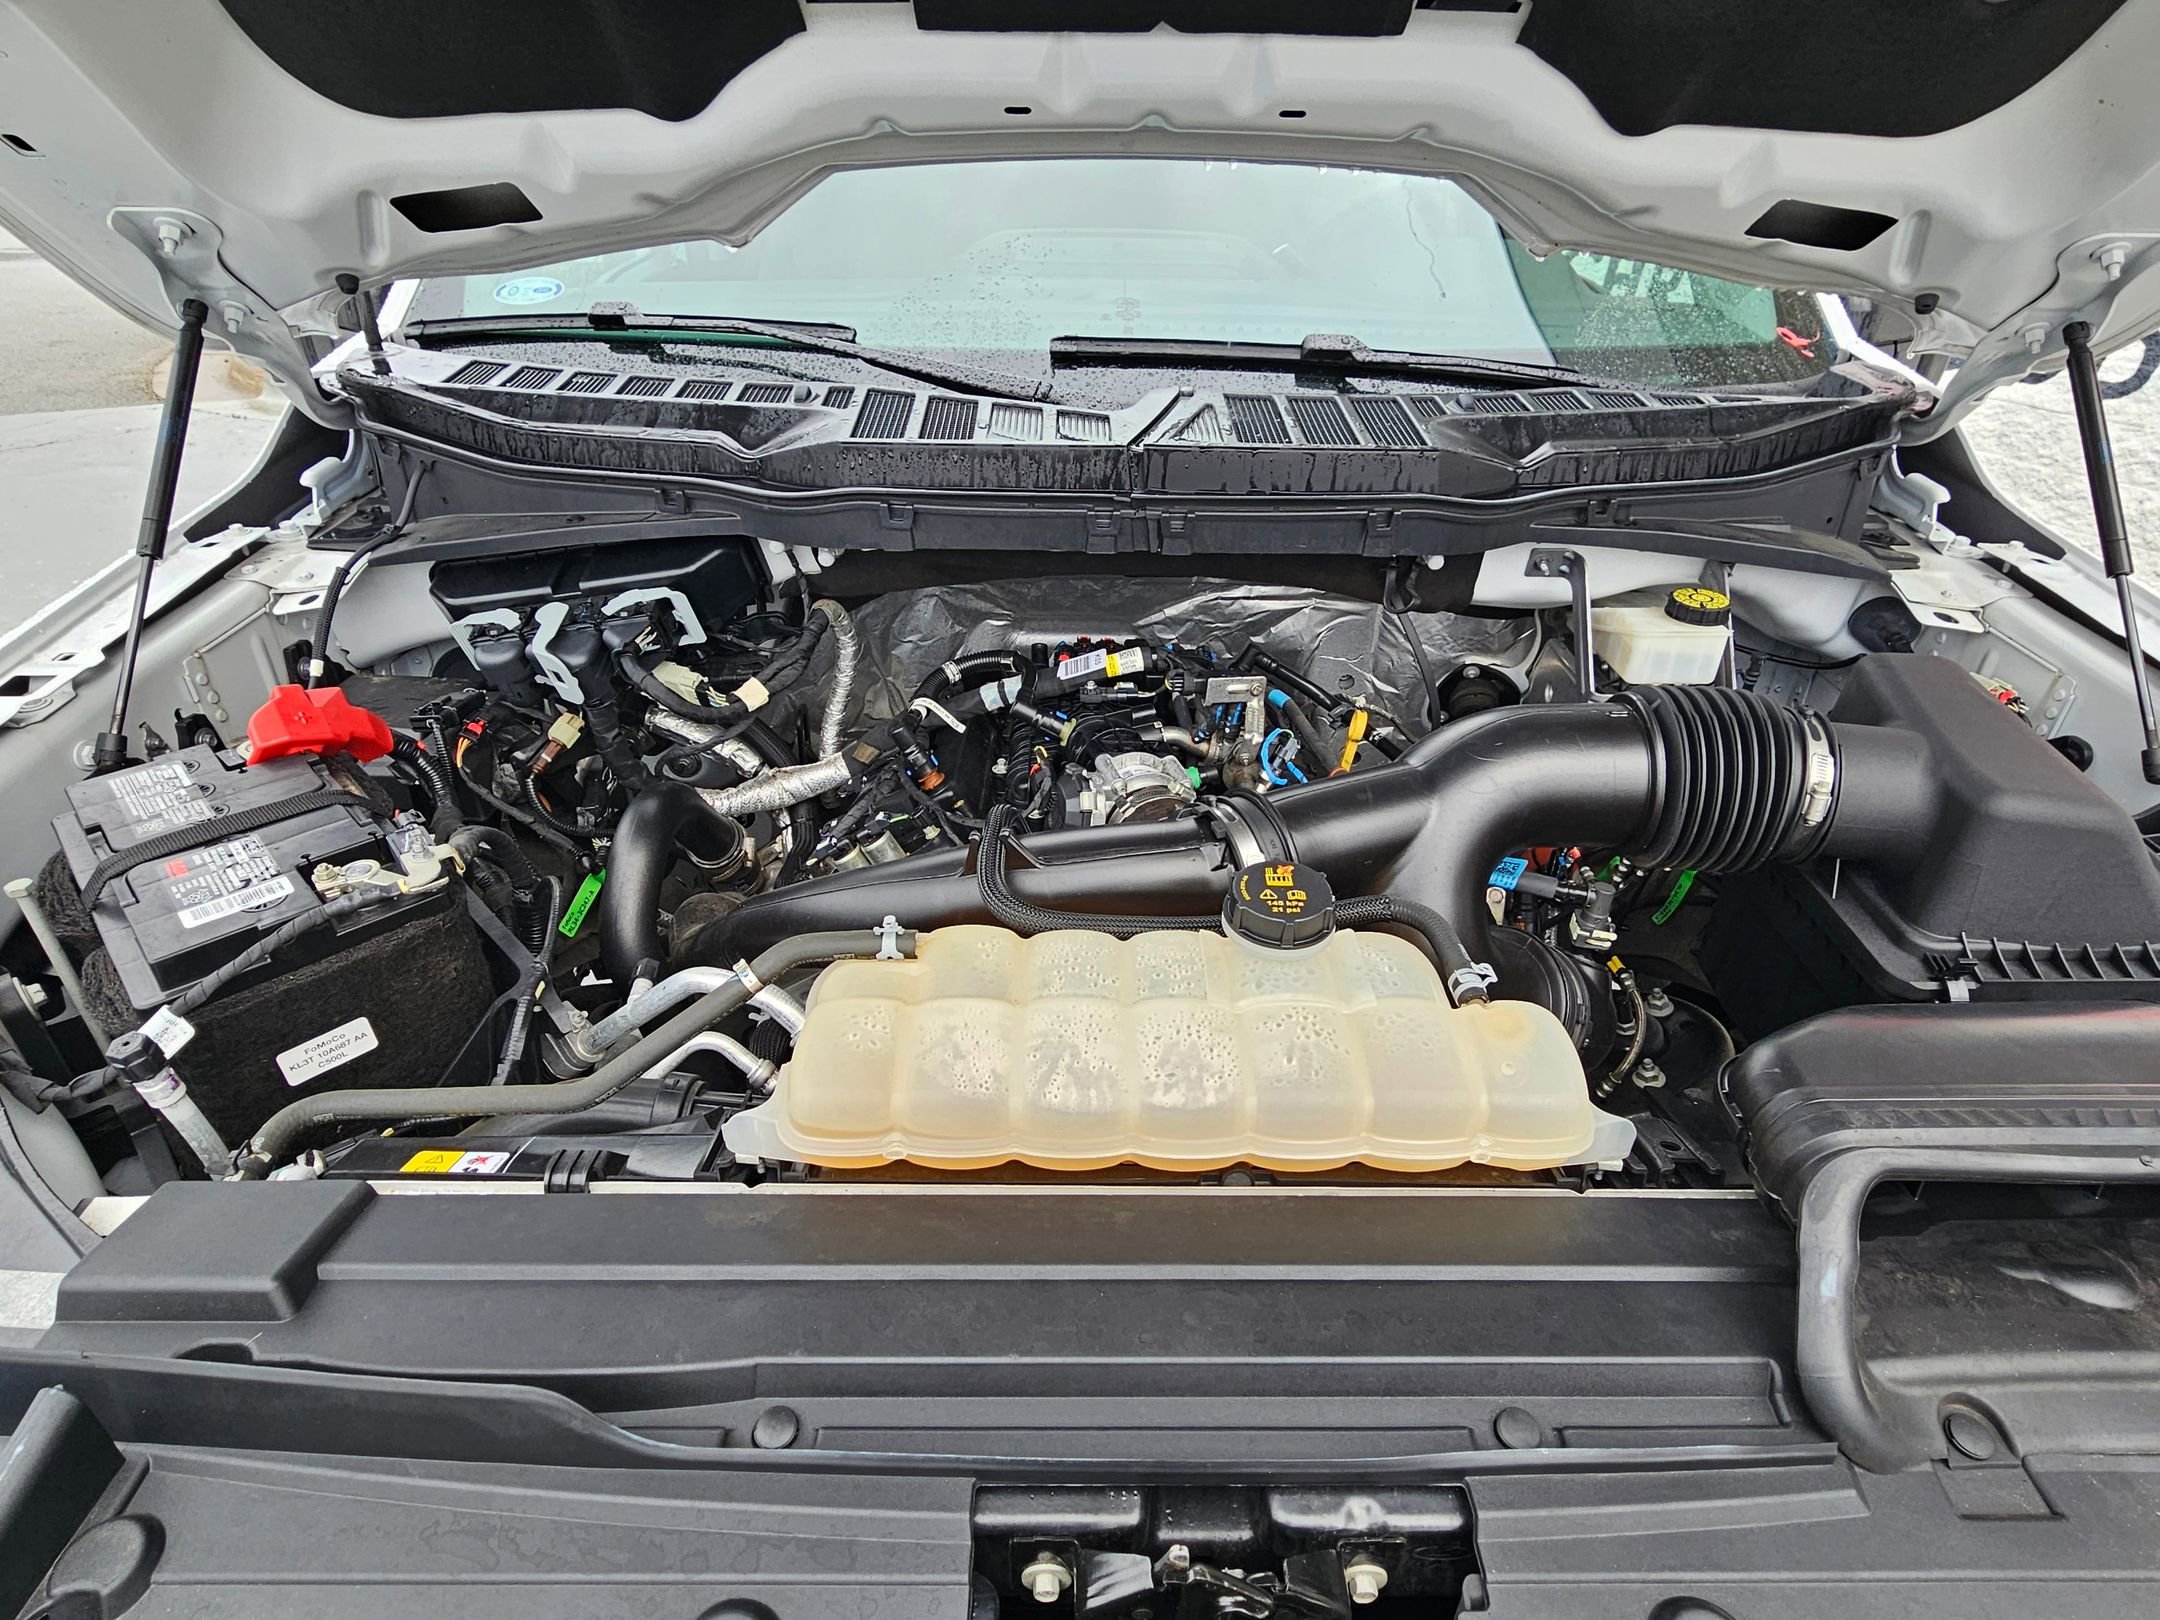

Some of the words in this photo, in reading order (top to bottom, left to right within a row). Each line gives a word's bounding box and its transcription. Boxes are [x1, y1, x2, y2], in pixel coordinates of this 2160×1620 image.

[289, 1056, 314, 1071] KL3T
[318, 1039, 351, 1058] 10A687
[354, 1032, 368, 1042] AA
[304, 1033, 346, 1054] FoMoCo
[318, 1052, 348, 1068] C500L
